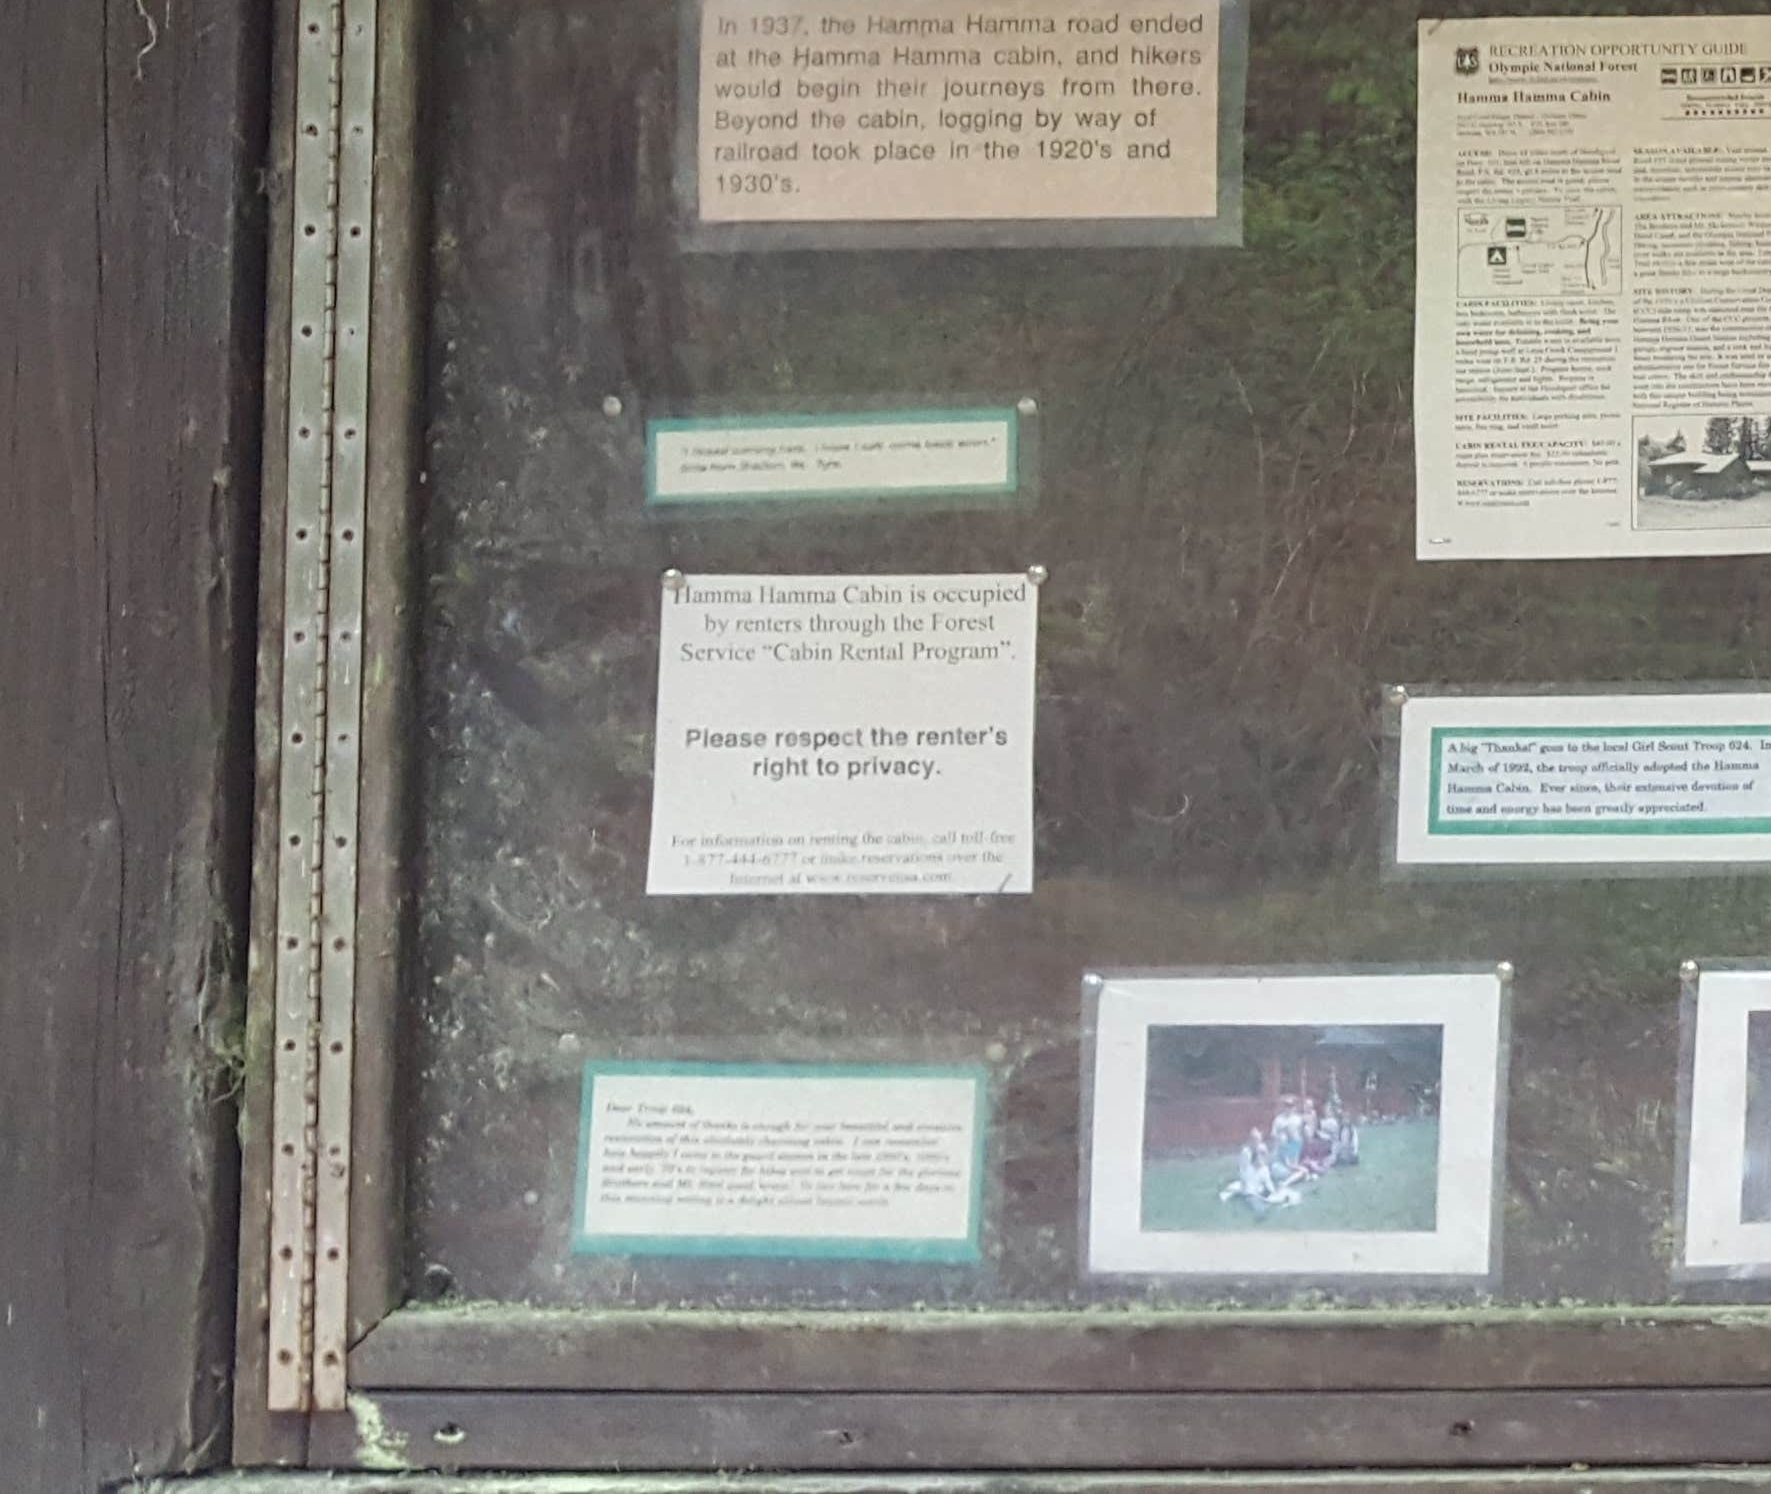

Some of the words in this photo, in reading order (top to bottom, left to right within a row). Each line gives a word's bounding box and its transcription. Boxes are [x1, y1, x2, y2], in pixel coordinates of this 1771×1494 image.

[718, 16, 737, 35] In
[750, 14, 809, 36] 1937,
[820, 15, 856, 35] the
[867, 14, 955, 39] Hamma
[966, 13, 1057, 37] Hamma
[1067, 13, 1120, 35] road
[1130, 13, 1205, 35] ended
[1489, 41, 1586, 58] RECREATION
[1589, 41, 1698, 58] OPPORTUNITY
[1701, 41, 1746, 56] GUIDE
[1487, 60, 1539, 76] Olympic
[1543, 59, 1596, 72] National
[1599, 59, 1638, 72] Forest
[1457, 90, 1509, 104] Hamma
[1512, 89, 1566, 103] Hamma
[1569, 89, 1611, 102] Cabin
[714, 107, 798, 135] Beyond
[810, 108, 846, 130] the
[856, 107, 926, 131] cabin,
[938, 107, 1023, 134] logging
[1034, 106, 1063, 133] by
[1073, 110, 1123, 133] way
[1133, 106, 1157, 128] of
[715, 169, 800, 194] 1930's.
[703, 612, 729, 637] by
[735, 616, 803, 634] renters
[808, 612, 886, 638] through
[892, 611, 924, 633] the
[930, 611, 995, 632] Forest
[685, 727, 767, 749] Please
[775, 727, 864, 752] respect
[869, 726, 909, 747] the
[916, 725, 1007, 746] renter's
[752, 755, 808, 782] right
[815, 756, 840, 777] to
[847, 755, 941, 781] privacy.
